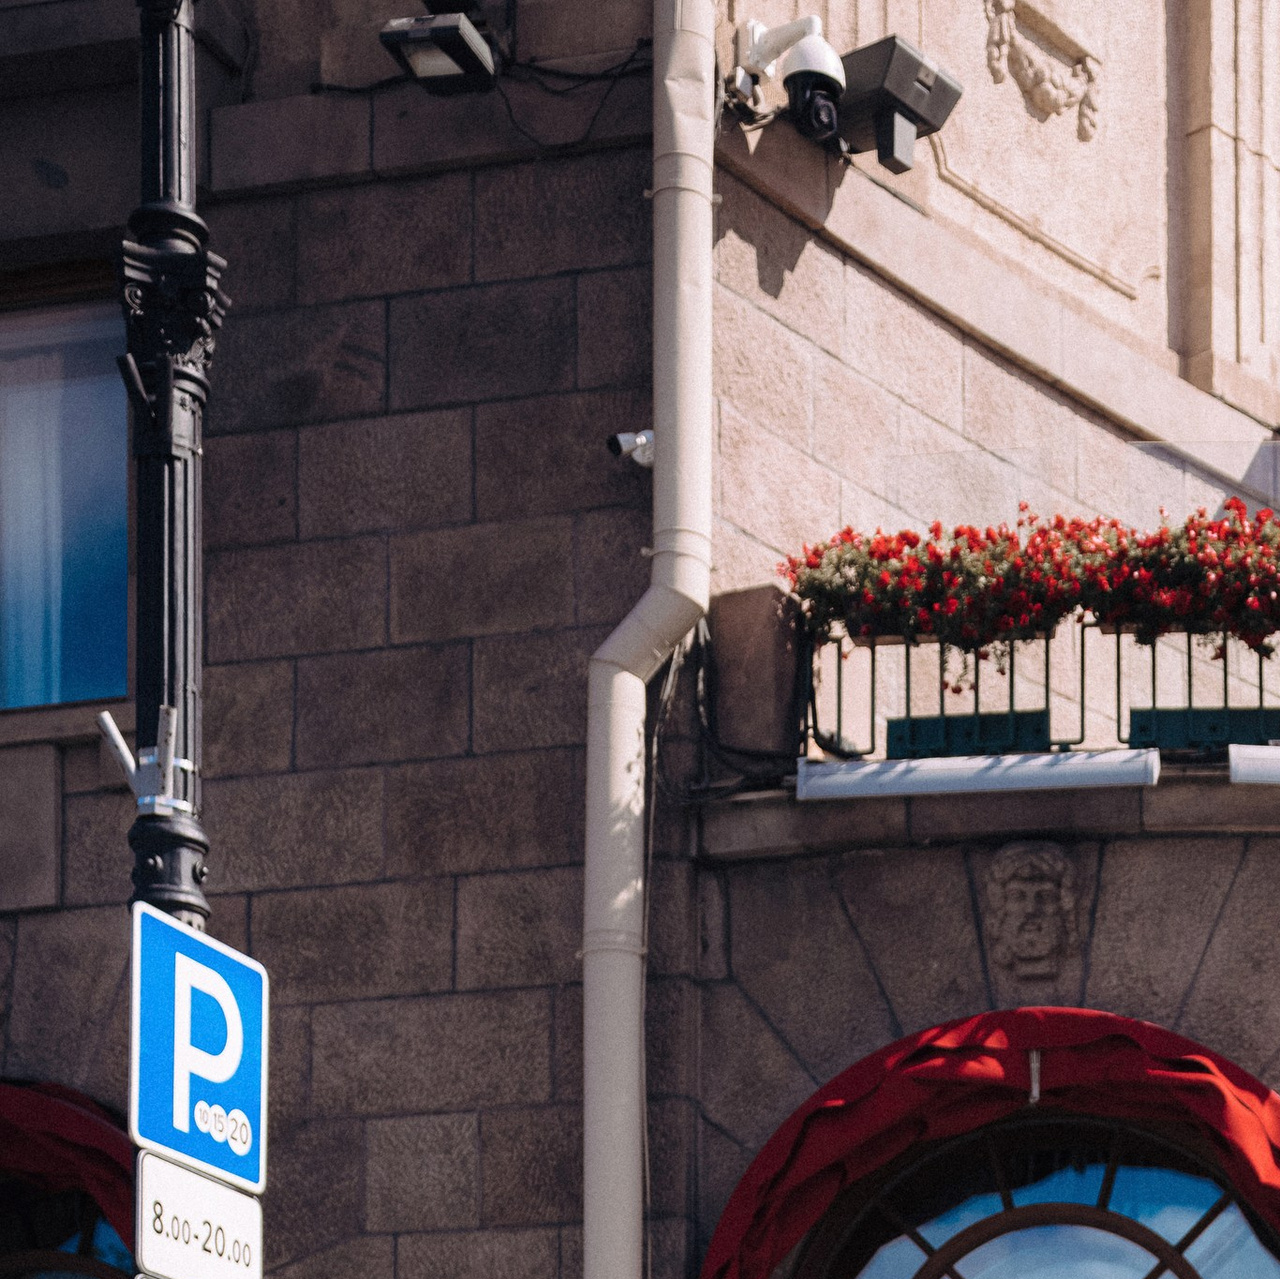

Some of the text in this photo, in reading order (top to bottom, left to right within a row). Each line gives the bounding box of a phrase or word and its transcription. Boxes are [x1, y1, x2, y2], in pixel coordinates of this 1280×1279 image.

[173, 951, 244, 1133] P
[199, 1109, 249, 1146] 10 15 20
[153, 1201, 251, 1267] 8.00-20.00
